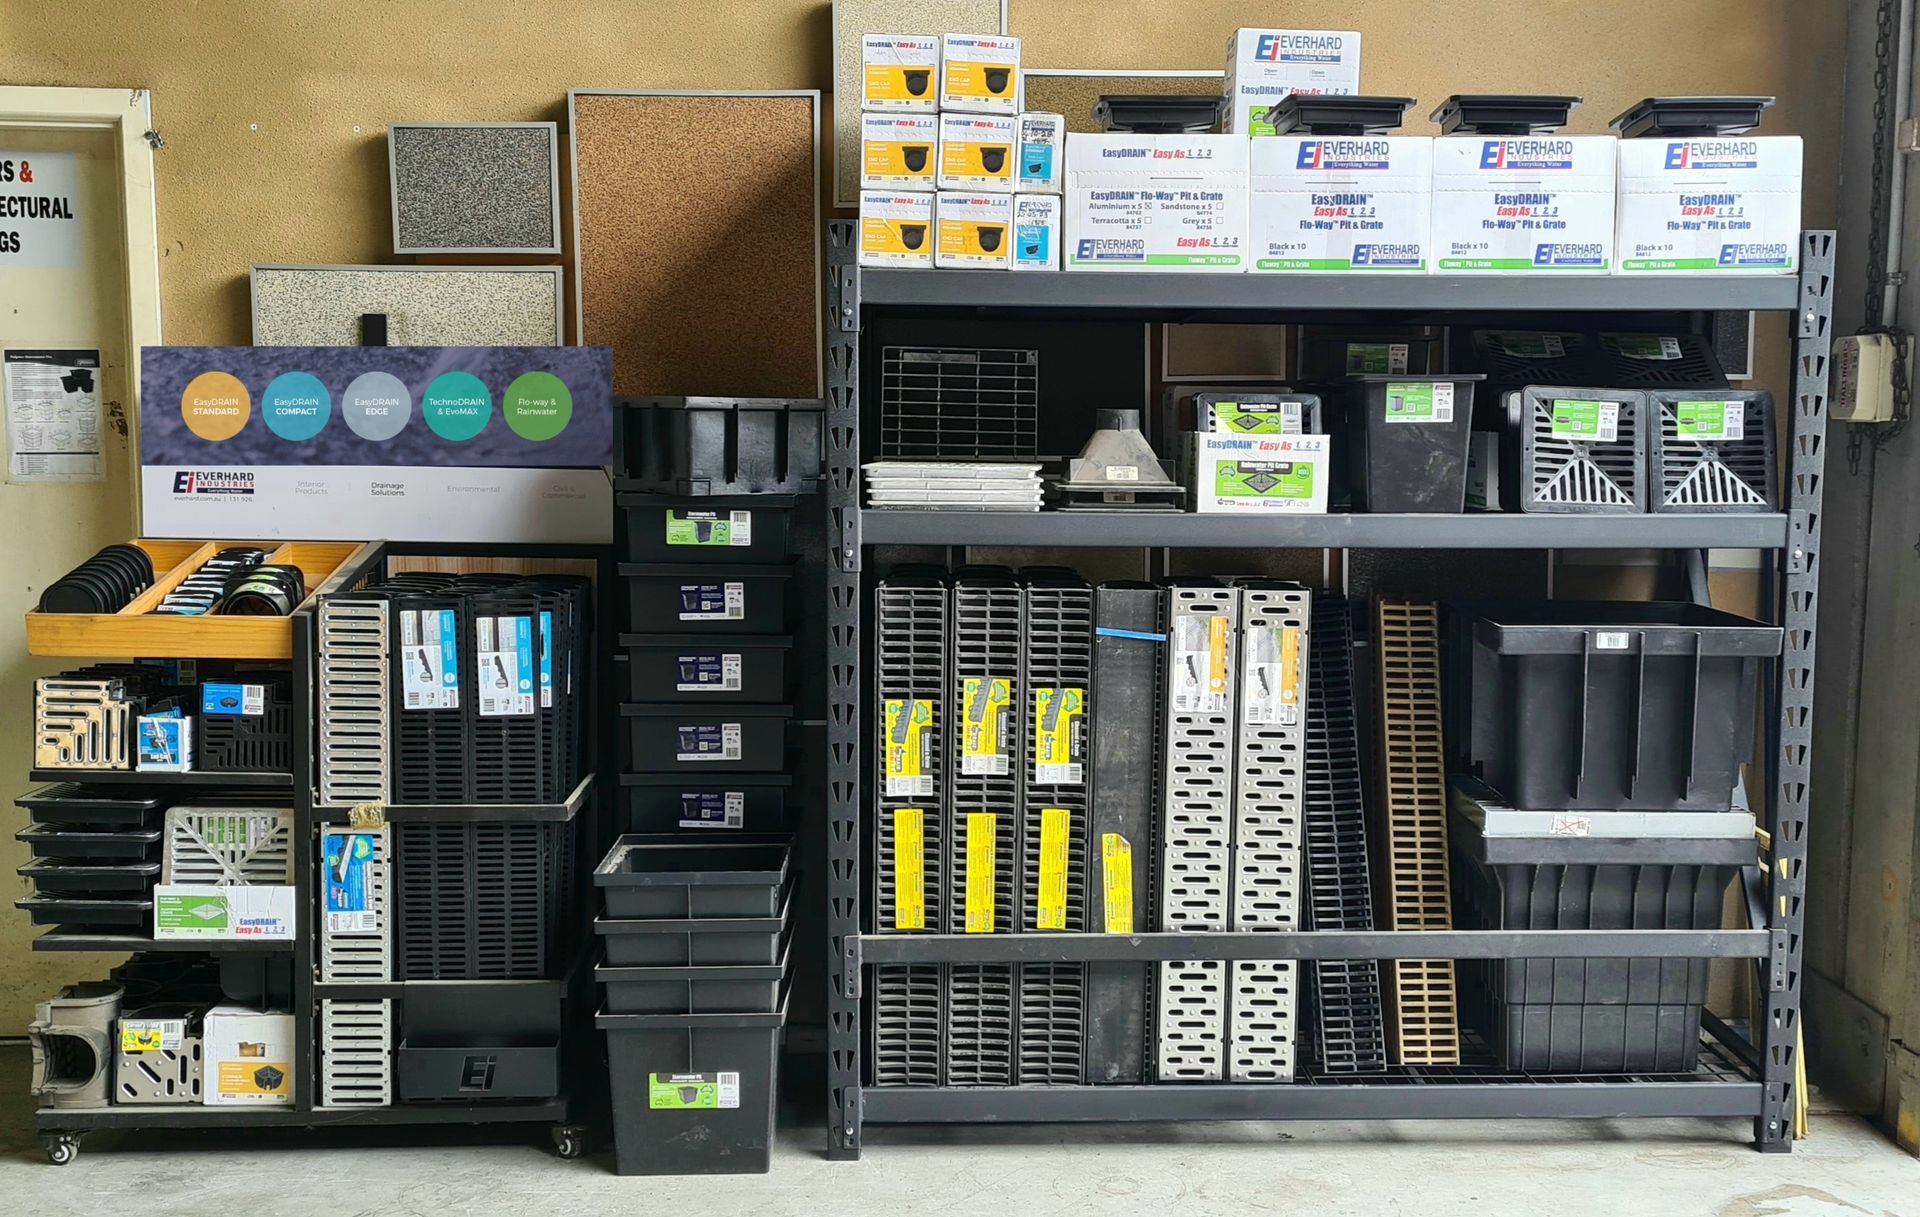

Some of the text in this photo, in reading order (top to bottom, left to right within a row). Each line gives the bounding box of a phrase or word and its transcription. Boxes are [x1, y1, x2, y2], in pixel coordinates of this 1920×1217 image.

[1281, 35, 1342, 49] EVERHARD
[1290, 87, 1309, 96] Easy
[1311, 88, 1321, 96] As
[1323, 141, 1389, 155] EVERHARD
[1507, 141, 1573, 155] EVERHARD
[1691, 142, 1757, 157] EVERHARD
[1153, 149, 1173, 160] Easy
[1174, 149, 1185, 159] As
[0, 160, 33, 183] S &
[1180, 191, 1191, 200] Pit
[1193, 192, 1199, 200] &
[1200, 191, 1223, 201] Grate
[1314, 206, 1335, 217] Easy
[1336, 207, 1347, 216] As
[1497, 206, 1518, 217] Easy
[1518, 206, 1530, 216] As
[1681, 206, 1715, 217] Easy As
[1182, 217, 1200, 226] Grey
[1340, 220, 1351, 230] Pit
[1352, 221, 1359, 229] &
[1360, 220, 1384, 230] Grate
[1522, 220, 1534, 229] Pit
[1535, 221, 1542, 229] &
[1543, 220, 1566, 229] Grate
[1708, 221, 1719, 230] Pit
[1720, 222, 1727, 230] &
[1728, 220, 1751, 230] Grate
[1096, 239, 1145, 250] EVERHARD
[1177, 237, 1210, 248] Easy As
[1451, 242, 1472, 250] Black
[1371, 244, 1420, 255] EVERHARD
[1554, 243, 1602, 254] EVERHARD
[1738, 244, 1787, 255] EVERHARD
[193, 398, 239, 407] EasyDRAIN
[274, 398, 319, 407] EasyDRAIN
[354, 398, 399, 407] EasyDRAIN
[429, 398, 485, 406] TechnoDRAIN
[518, 398, 556, 407] Flo-way &
[192, 408, 239, 416] STANDARD
[275, 408, 318, 416] COMPACT
[365, 408, 389, 416] EDGE
[1259, 440, 1280, 451] Easy
[1280, 441, 1293, 450] As
[196, 472, 254, 481] EVERHARD
[297, 481, 325, 489] Interior
[371, 482, 404, 491] Drainage
[447, 485, 500, 493] Environmental
[295, 488, 328, 496] Products
[235, 927, 251, 935] Easy
